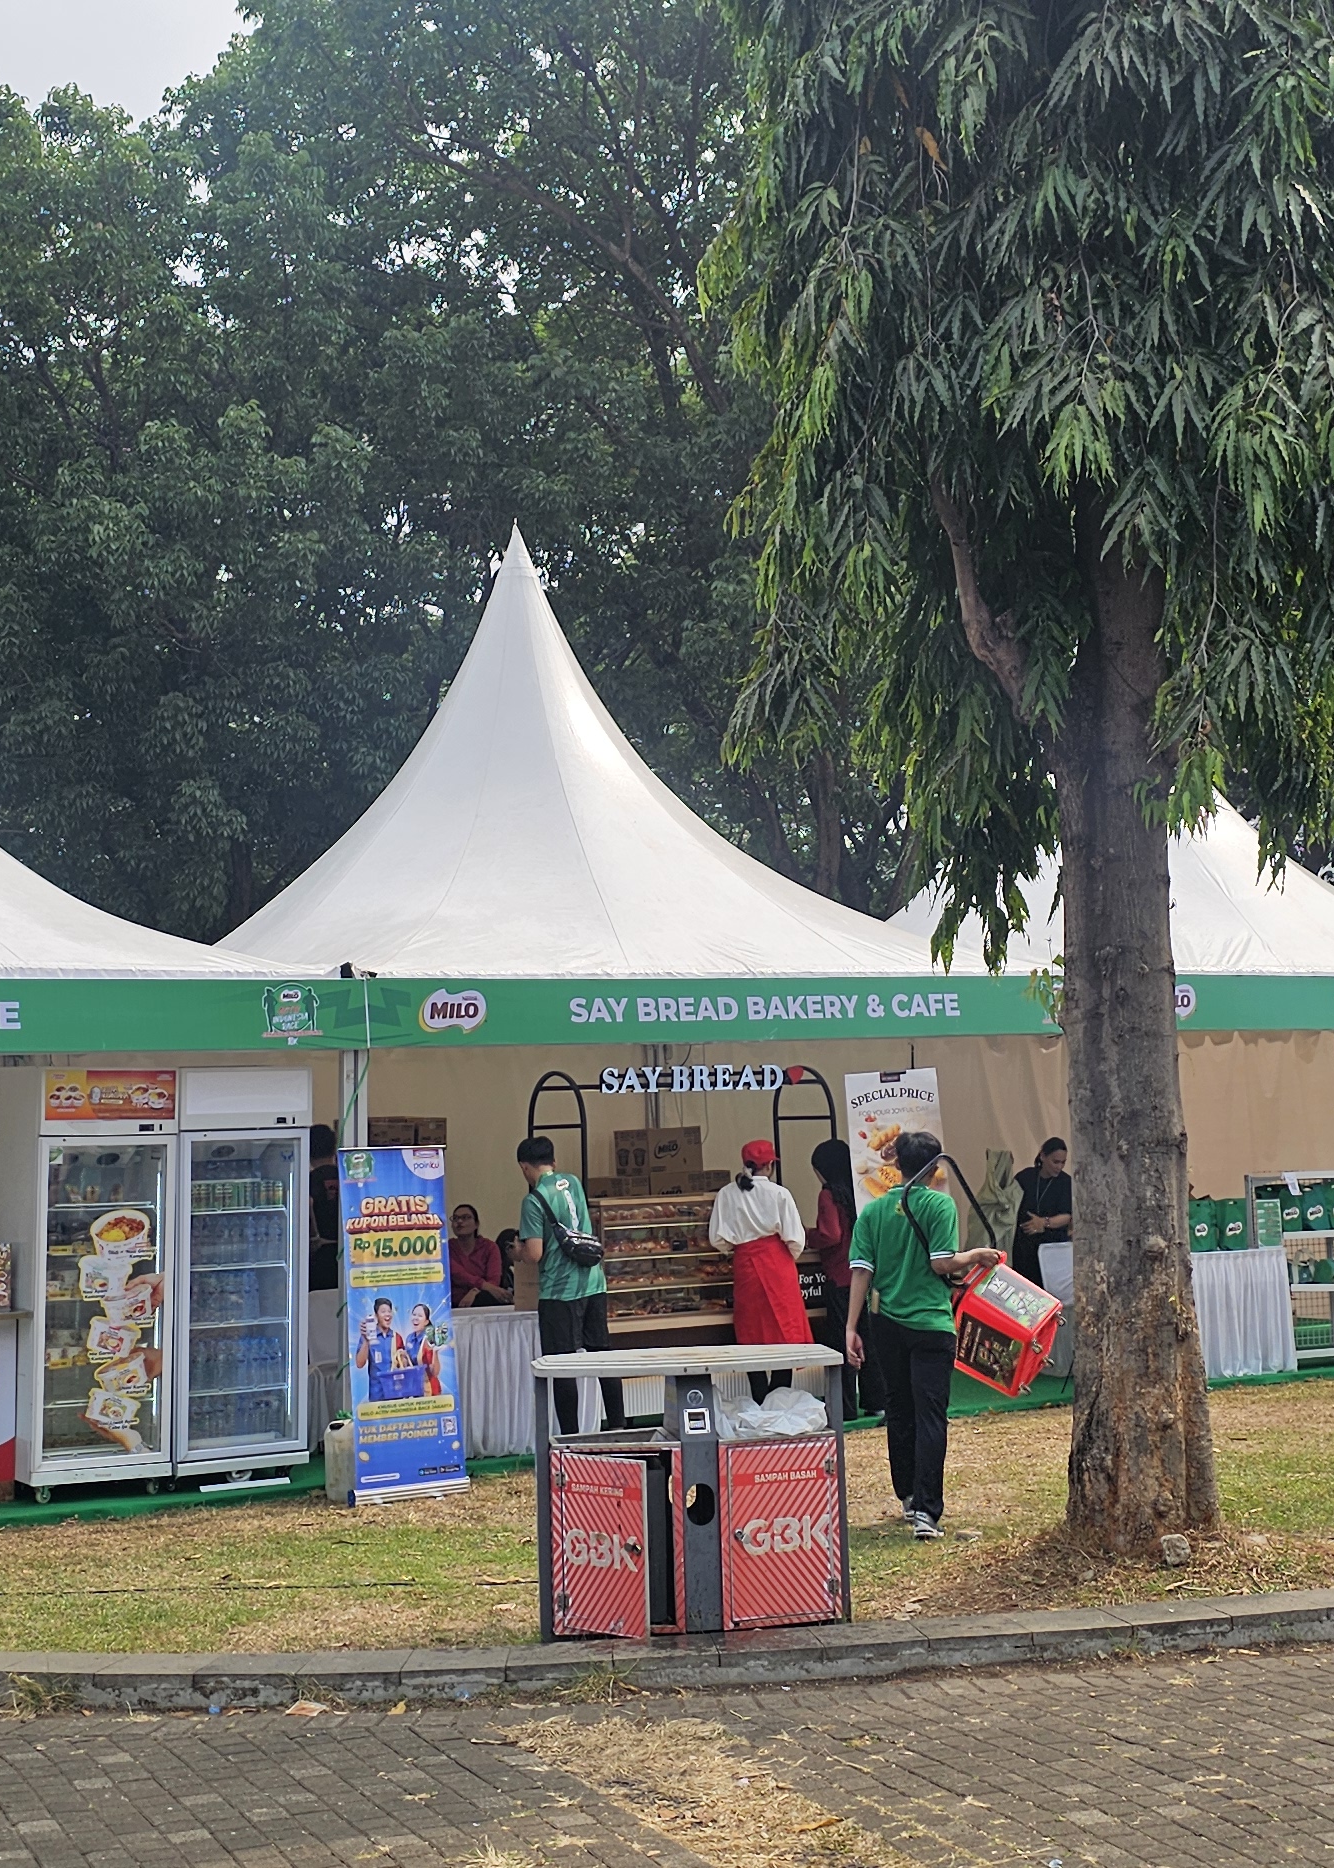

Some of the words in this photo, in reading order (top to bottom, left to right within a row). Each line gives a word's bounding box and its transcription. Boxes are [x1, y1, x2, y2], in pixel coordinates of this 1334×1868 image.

[570, 996, 628, 1023] SAY
[636, 996, 739, 1022] BREAD
[747, 994, 859, 1020] BAKERY
[866, 993, 885, 1018] &
[891, 993, 961, 1018] CAFE
[1174, 994, 1191, 1008] LO
[430, 1001, 479, 1020] MILO
[601, 1066, 663, 1095] SAY
[670, 1064, 784, 1093] BREAD
[850, 1087, 897, 1110] SPECIAL
[899, 1087, 935, 1103] PRICE
[658, 1142, 679, 1154] MILO
[360, 1195, 428, 1215] GRATIS
[346, 1214, 387, 1230] KUPON
[388, 1213, 443, 1227] BELANJA
[353, 1238, 371, 1253] Rp
[373, 1235, 438, 1259] 15.000
[799, 1274, 813, 1284] For
[800, 1285, 822, 1300] oyful
[358, 1425, 377, 1435] YUK
[379, 1421, 415, 1433] DAFTAR
[359, 1432, 399, 1445] MEMBER
[754, 1471, 789, 1483] SAMPAH
[790, 1469, 817, 1481] BASAH
[571, 1482, 599, 1496] SAMPAH
[742, 1514, 831, 1556] GBK
[565, 1529, 639, 1573] GBK
